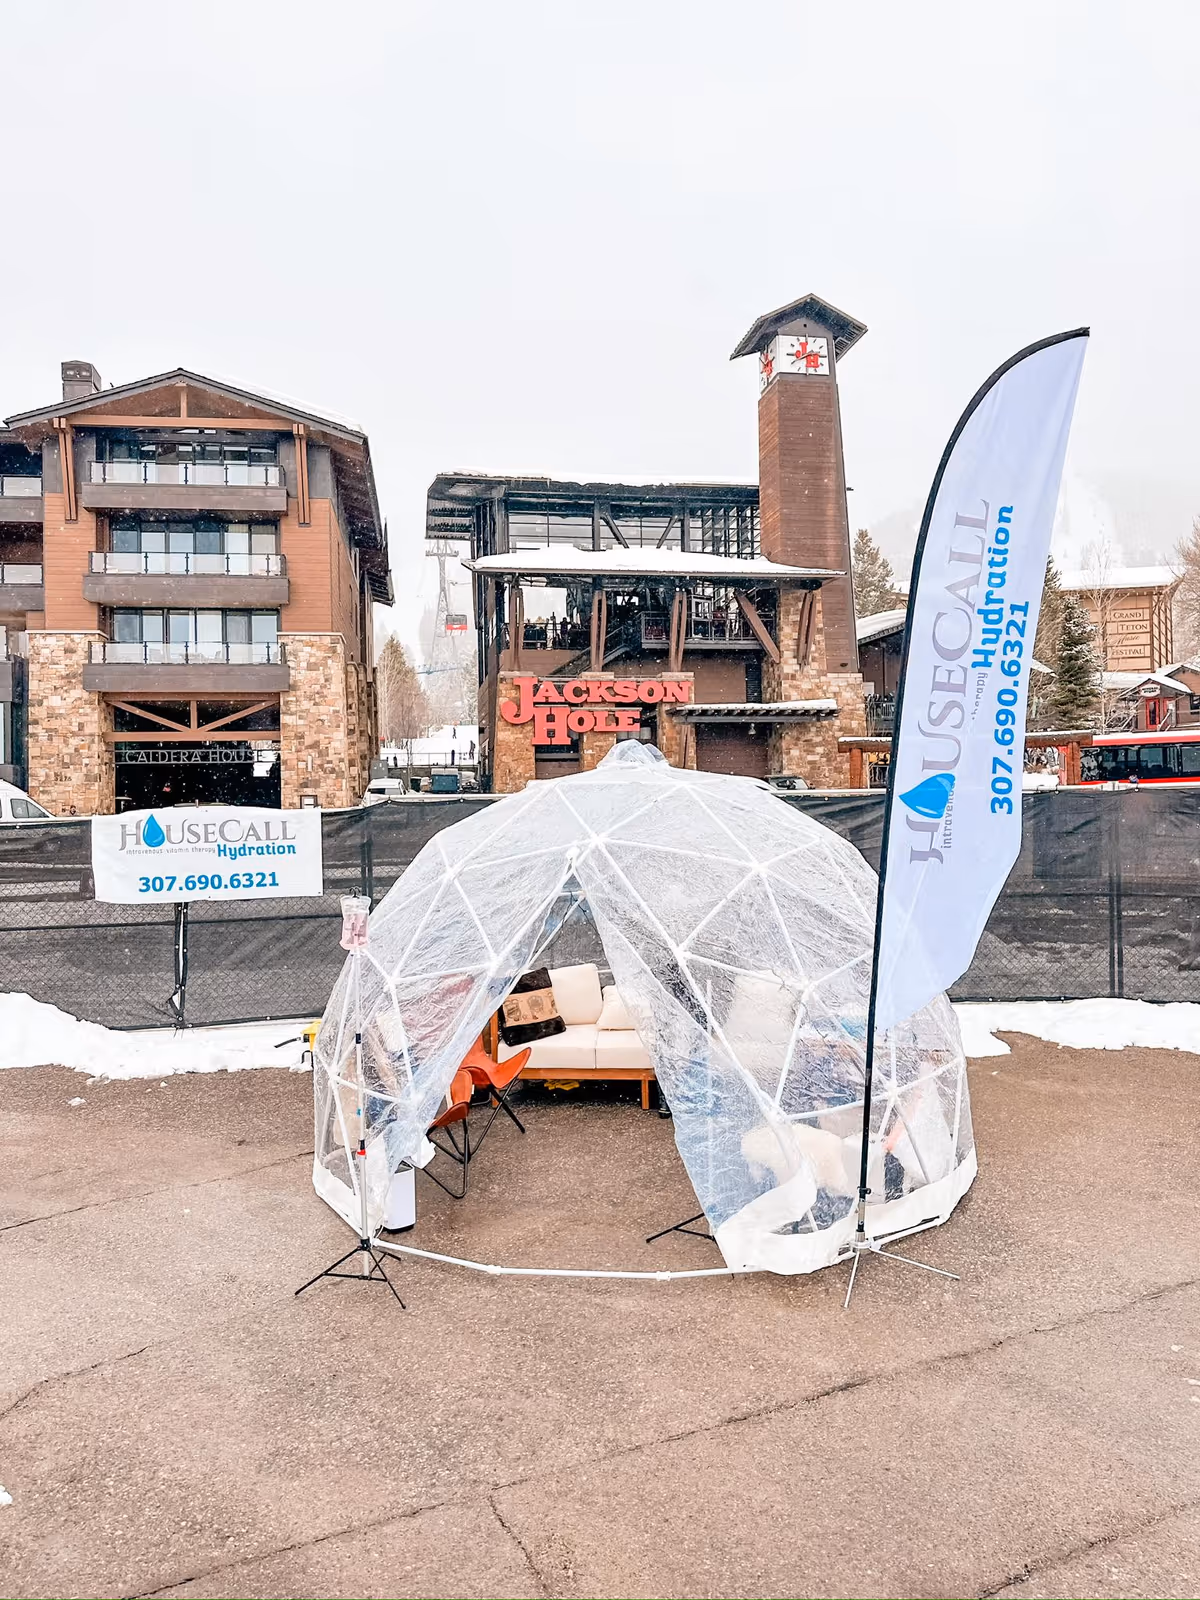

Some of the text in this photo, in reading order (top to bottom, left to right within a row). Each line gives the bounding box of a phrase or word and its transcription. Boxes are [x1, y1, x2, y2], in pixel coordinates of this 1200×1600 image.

[971, 505, 1014, 669] Hydration
[1113, 611, 1142, 619] GRAND
[1119, 623, 1148, 631] TETON
[500, 676, 692, 725] JACKSON
[990, 600, 1030, 815] 307.690.6321
[531, 706, 641, 745] HOLE
[125, 750, 263, 763] CALDERA HOUSE
[191, 846, 216, 854] therapy
[216, 842, 297, 861] Hydration
[138, 871, 280, 893] 307.690.6321
